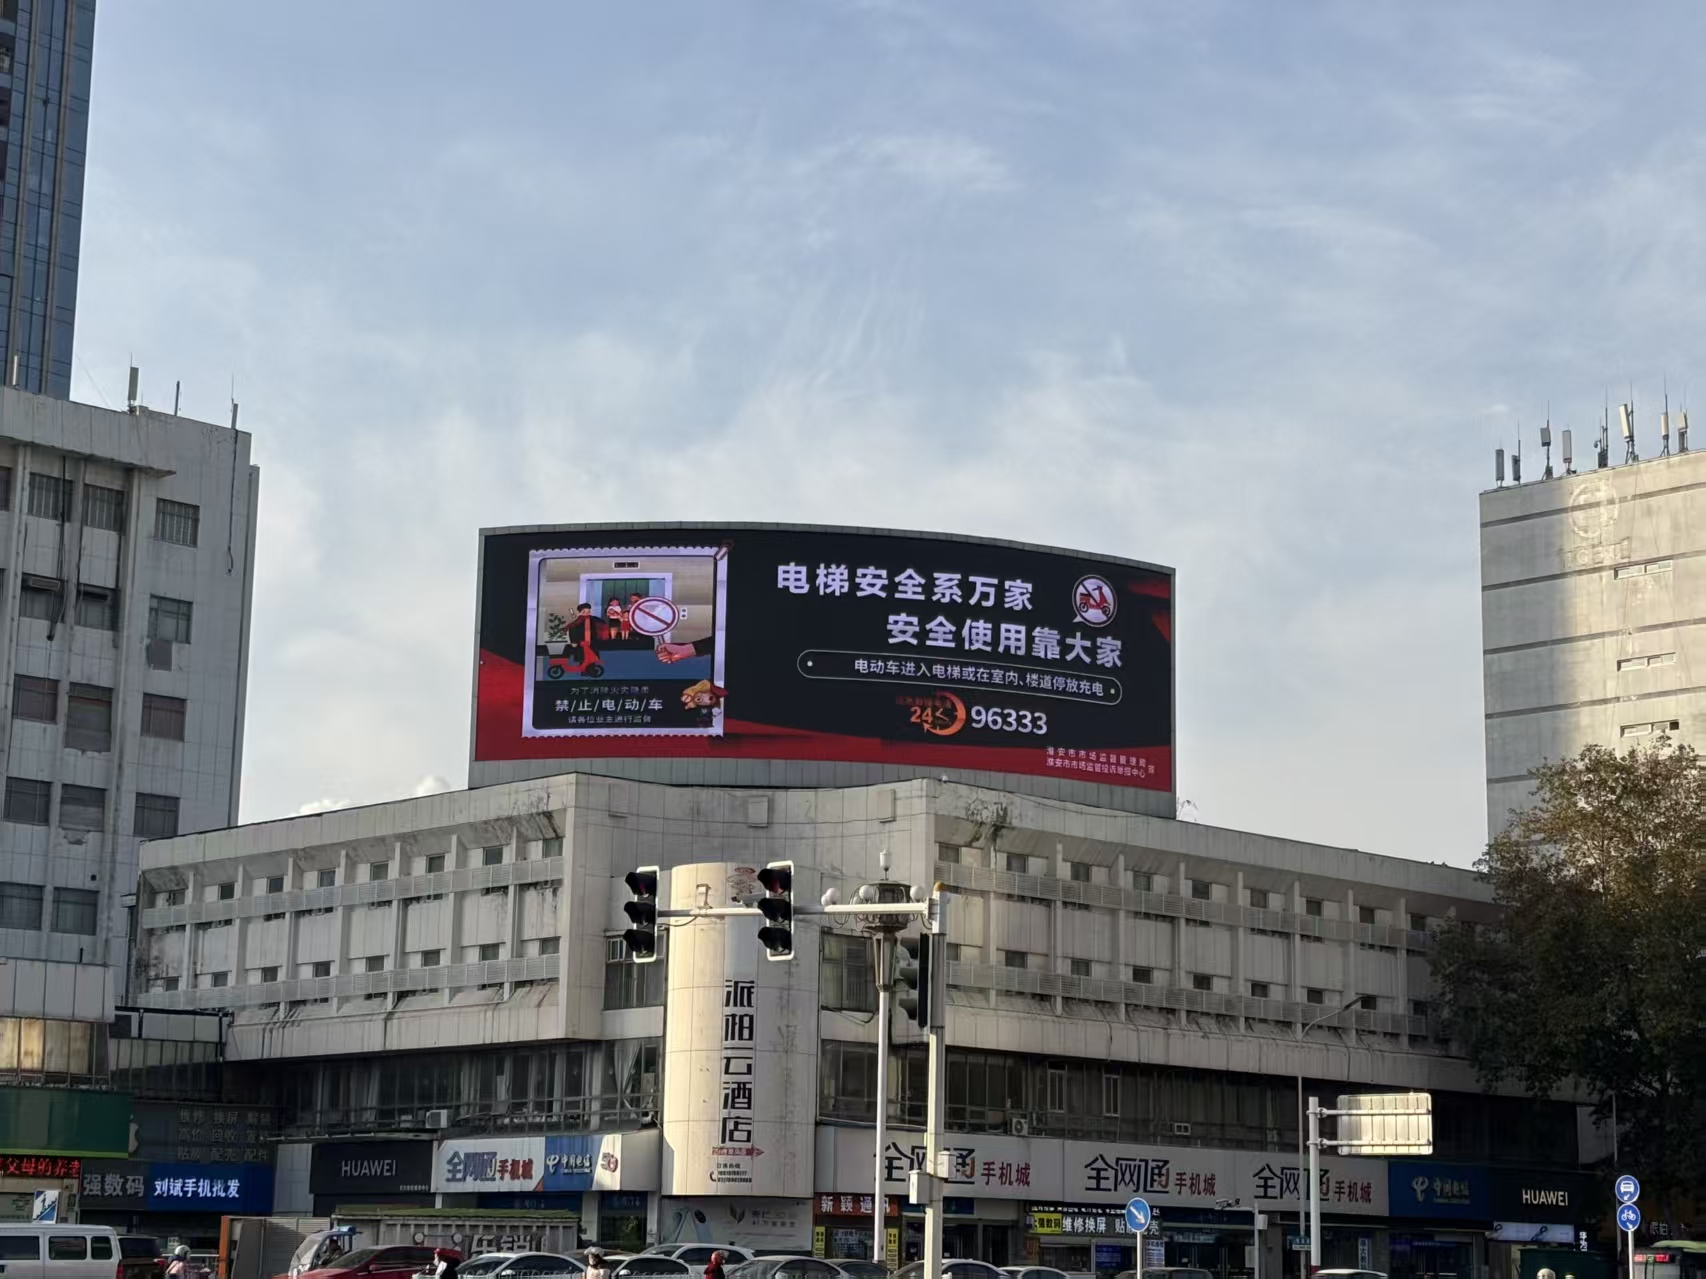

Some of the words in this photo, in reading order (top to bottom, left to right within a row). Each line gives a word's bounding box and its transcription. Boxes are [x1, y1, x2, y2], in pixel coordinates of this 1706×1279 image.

[777, 561, 1033, 612] 电梯安全系万家
[886, 612, 1123, 668] 安全使用靠大家
[853, 657, 1105, 697] 电动车进入电梯或在室内、楼道停放充电
[911, 706, 934, 724] 24
[970, 705, 1048, 735] 96333
[0, 1158, 80, 1178] 父母的养老
[341, 1159, 397, 1177] HUAWEI
[981, 1160, 1031, 1187] 手机城
[1084, 1154, 1170, 1194] 全网通
[1174, 1171, 1216, 1197] 手机城
[154, 1178, 241, 1200] 刘斌手机批发
[1334, 1180, 1372, 1204] 手机城
[1522, 1188, 1569, 1206] HUAWEI
[1062, 1216, 1106, 1234] 维修换屏
